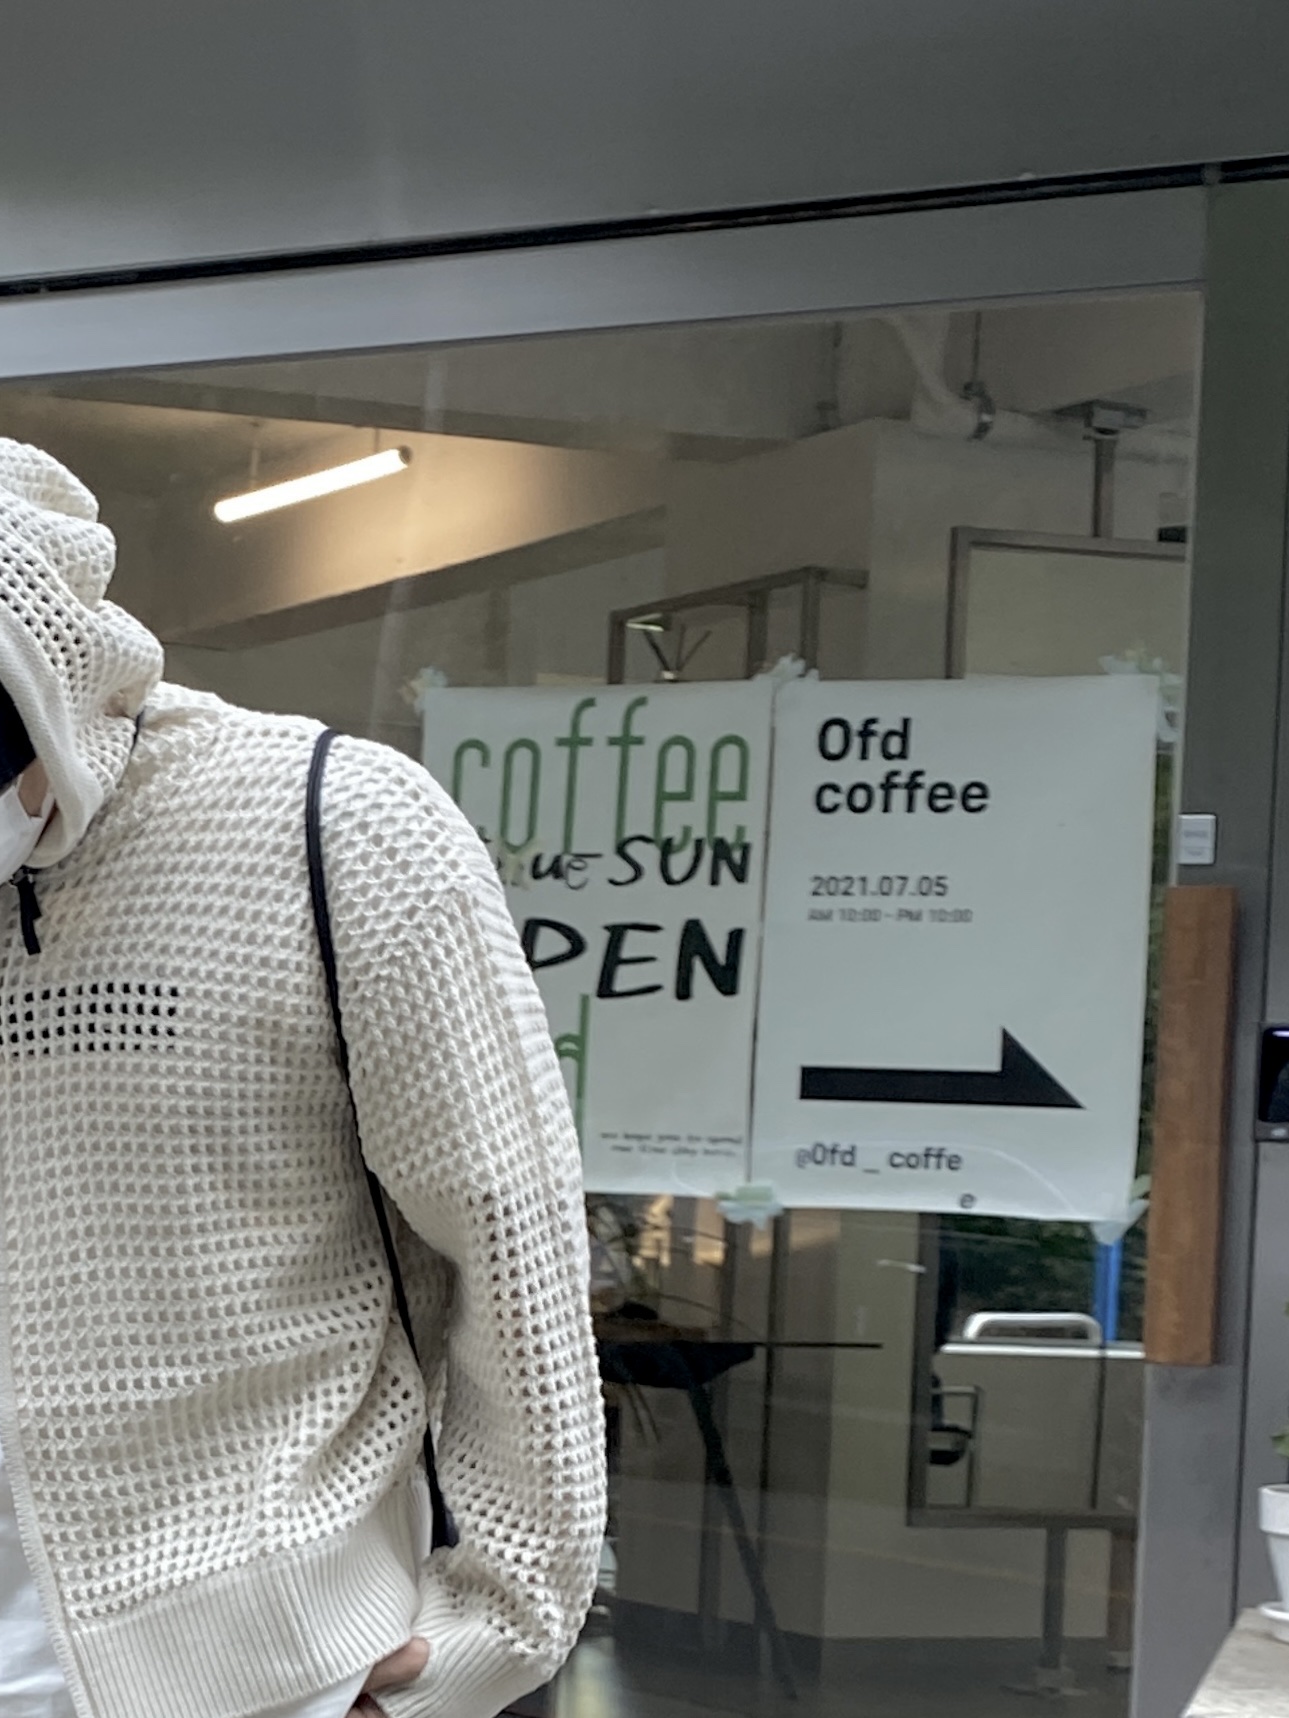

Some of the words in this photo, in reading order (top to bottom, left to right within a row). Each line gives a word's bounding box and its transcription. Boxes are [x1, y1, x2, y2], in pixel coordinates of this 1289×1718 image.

[815, 769, 991, 814] coffee
[607, 833, 751, 888] SUN
[810, 875, 949, 897] 2021.07.05
[521, 916, 746, 1001] PEN
